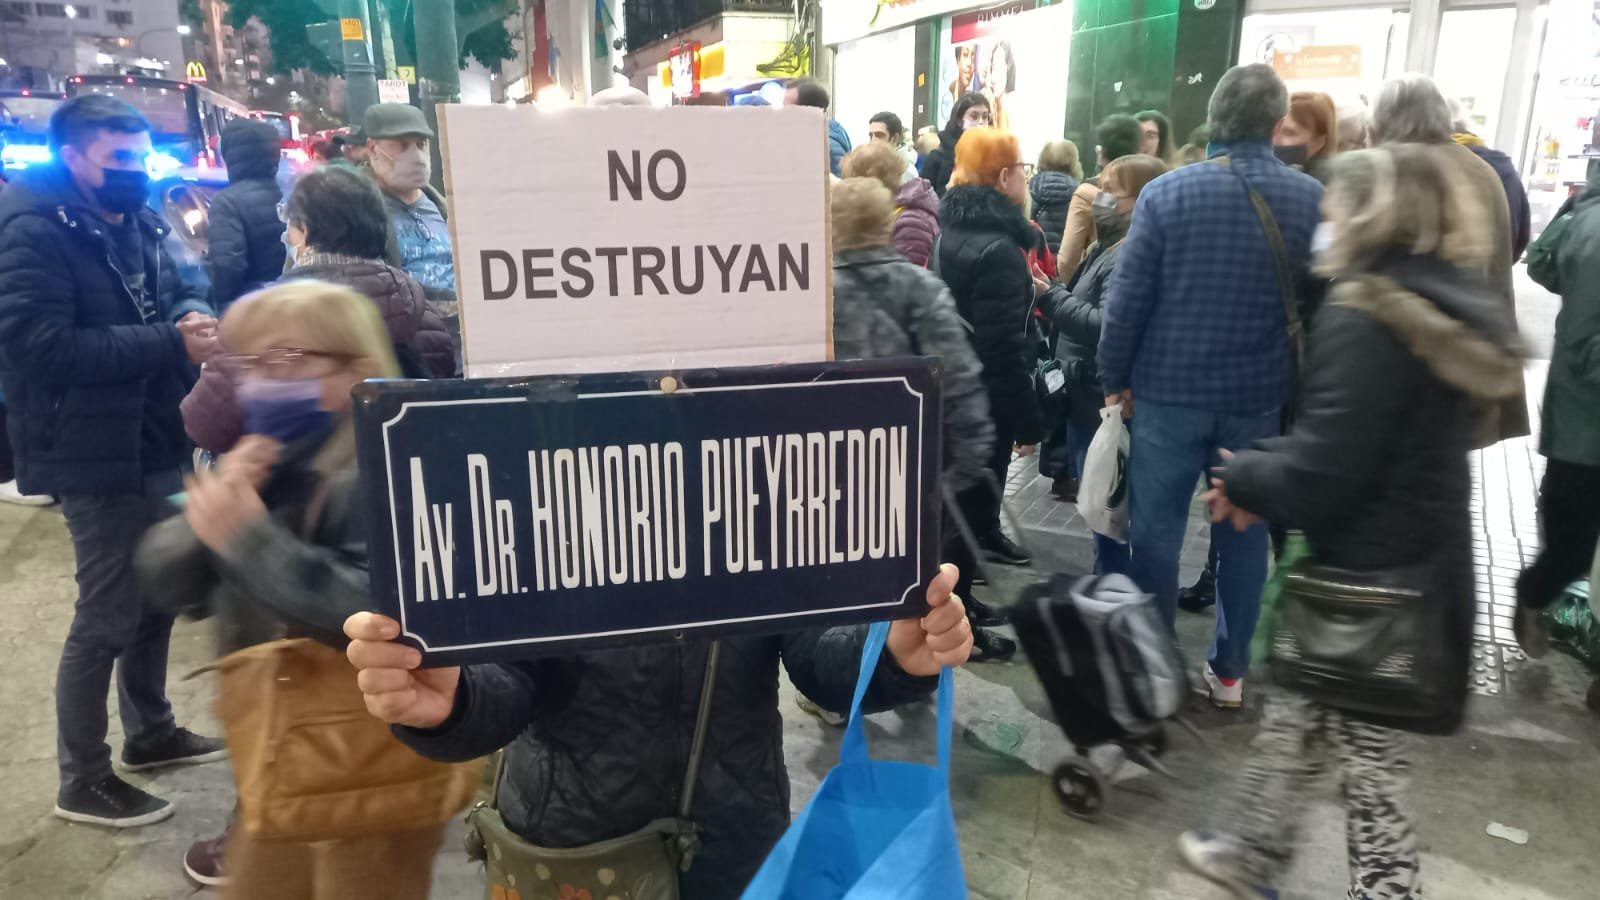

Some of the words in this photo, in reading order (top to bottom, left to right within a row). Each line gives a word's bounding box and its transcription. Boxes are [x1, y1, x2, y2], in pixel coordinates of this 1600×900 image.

[607, 149, 687, 202] NO
[479, 242, 810, 301] DESTRUYAN
[527, 441, 687, 592] HONORIO
[701, 425, 908, 577] PUEYRREDON
